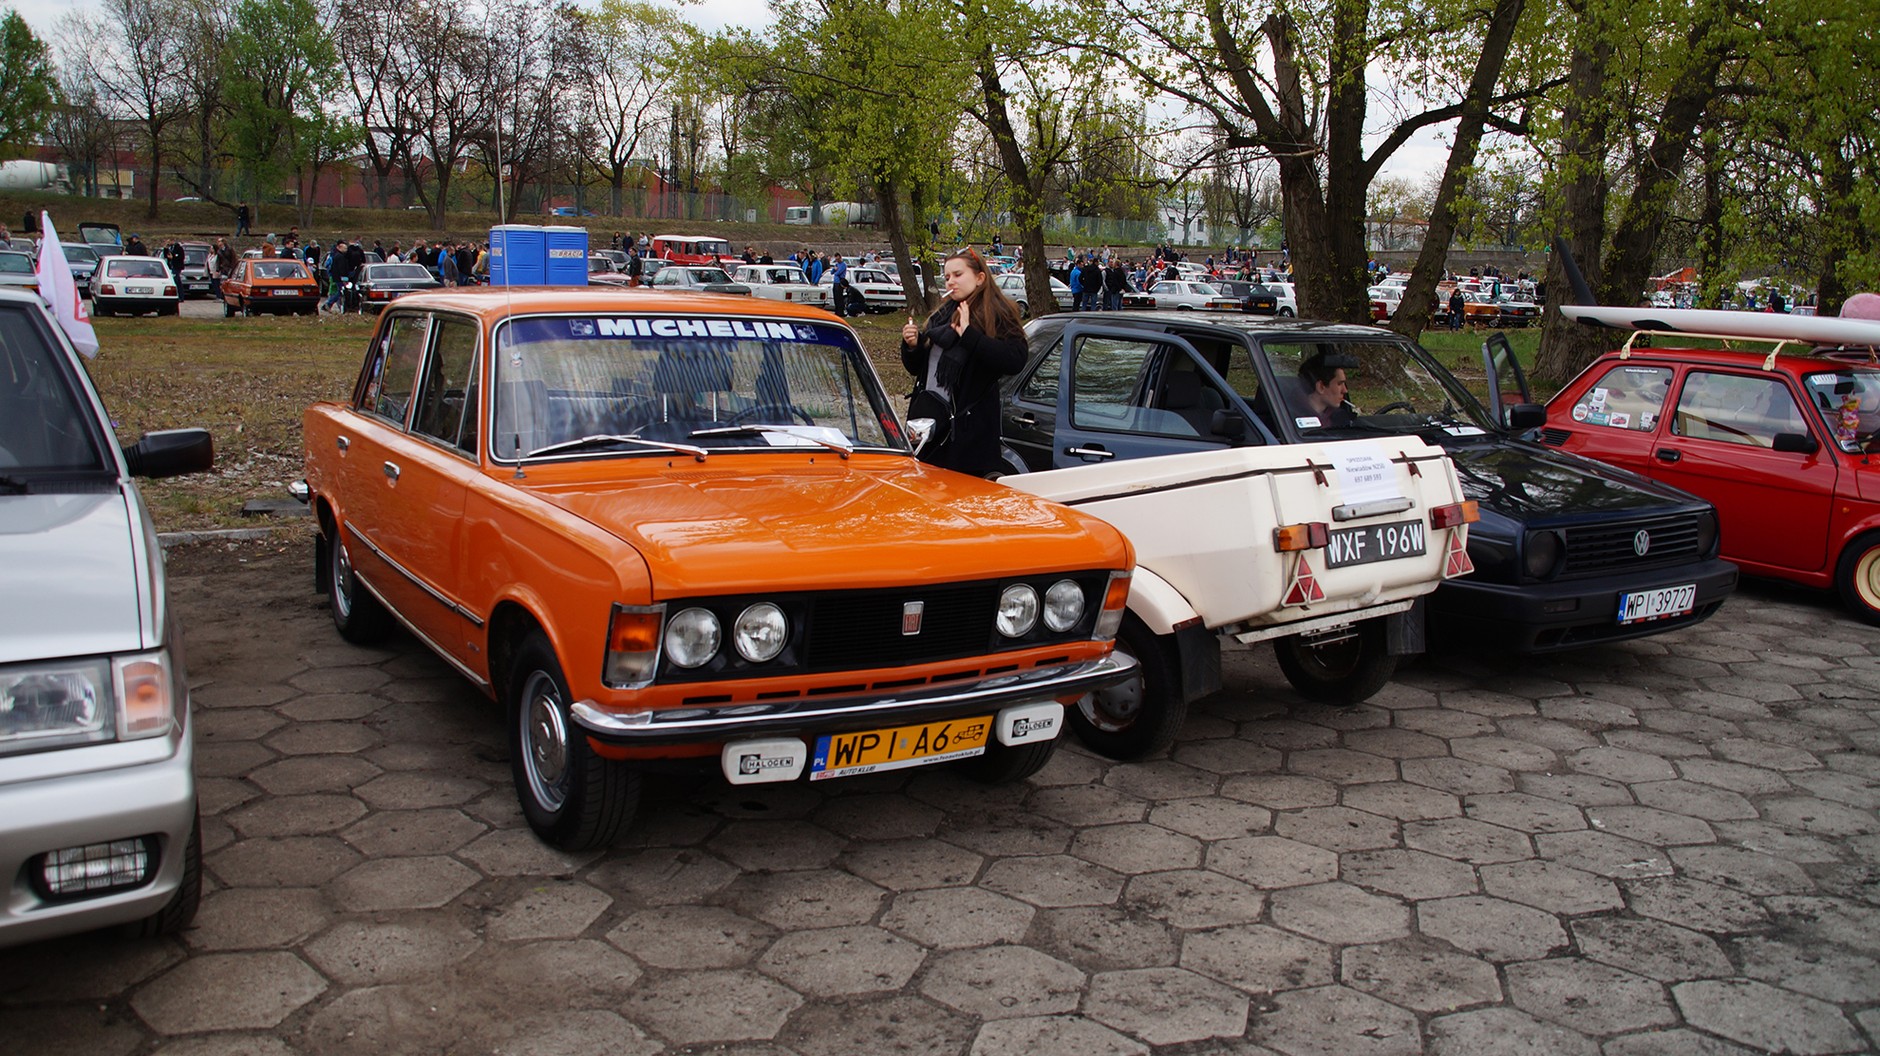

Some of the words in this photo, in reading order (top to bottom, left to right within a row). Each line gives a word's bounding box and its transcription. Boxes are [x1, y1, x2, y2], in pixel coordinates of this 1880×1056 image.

[597, 318, 796, 340] MICHELIN
[1328, 530, 1367, 563] WXF
[1376, 523, 1423, 556] 196W
[1655, 586, 1695, 612] 39727
[904, 614, 921, 631] FIAT
[1019, 719, 1052, 732] HALOGEN
[834, 731, 898, 766] WPI
[912, 724, 952, 756] A6
[749, 759, 792, 768] HALOGEN
[813, 757, 825, 766] PL
[839, 767, 857, 775] AUTO
